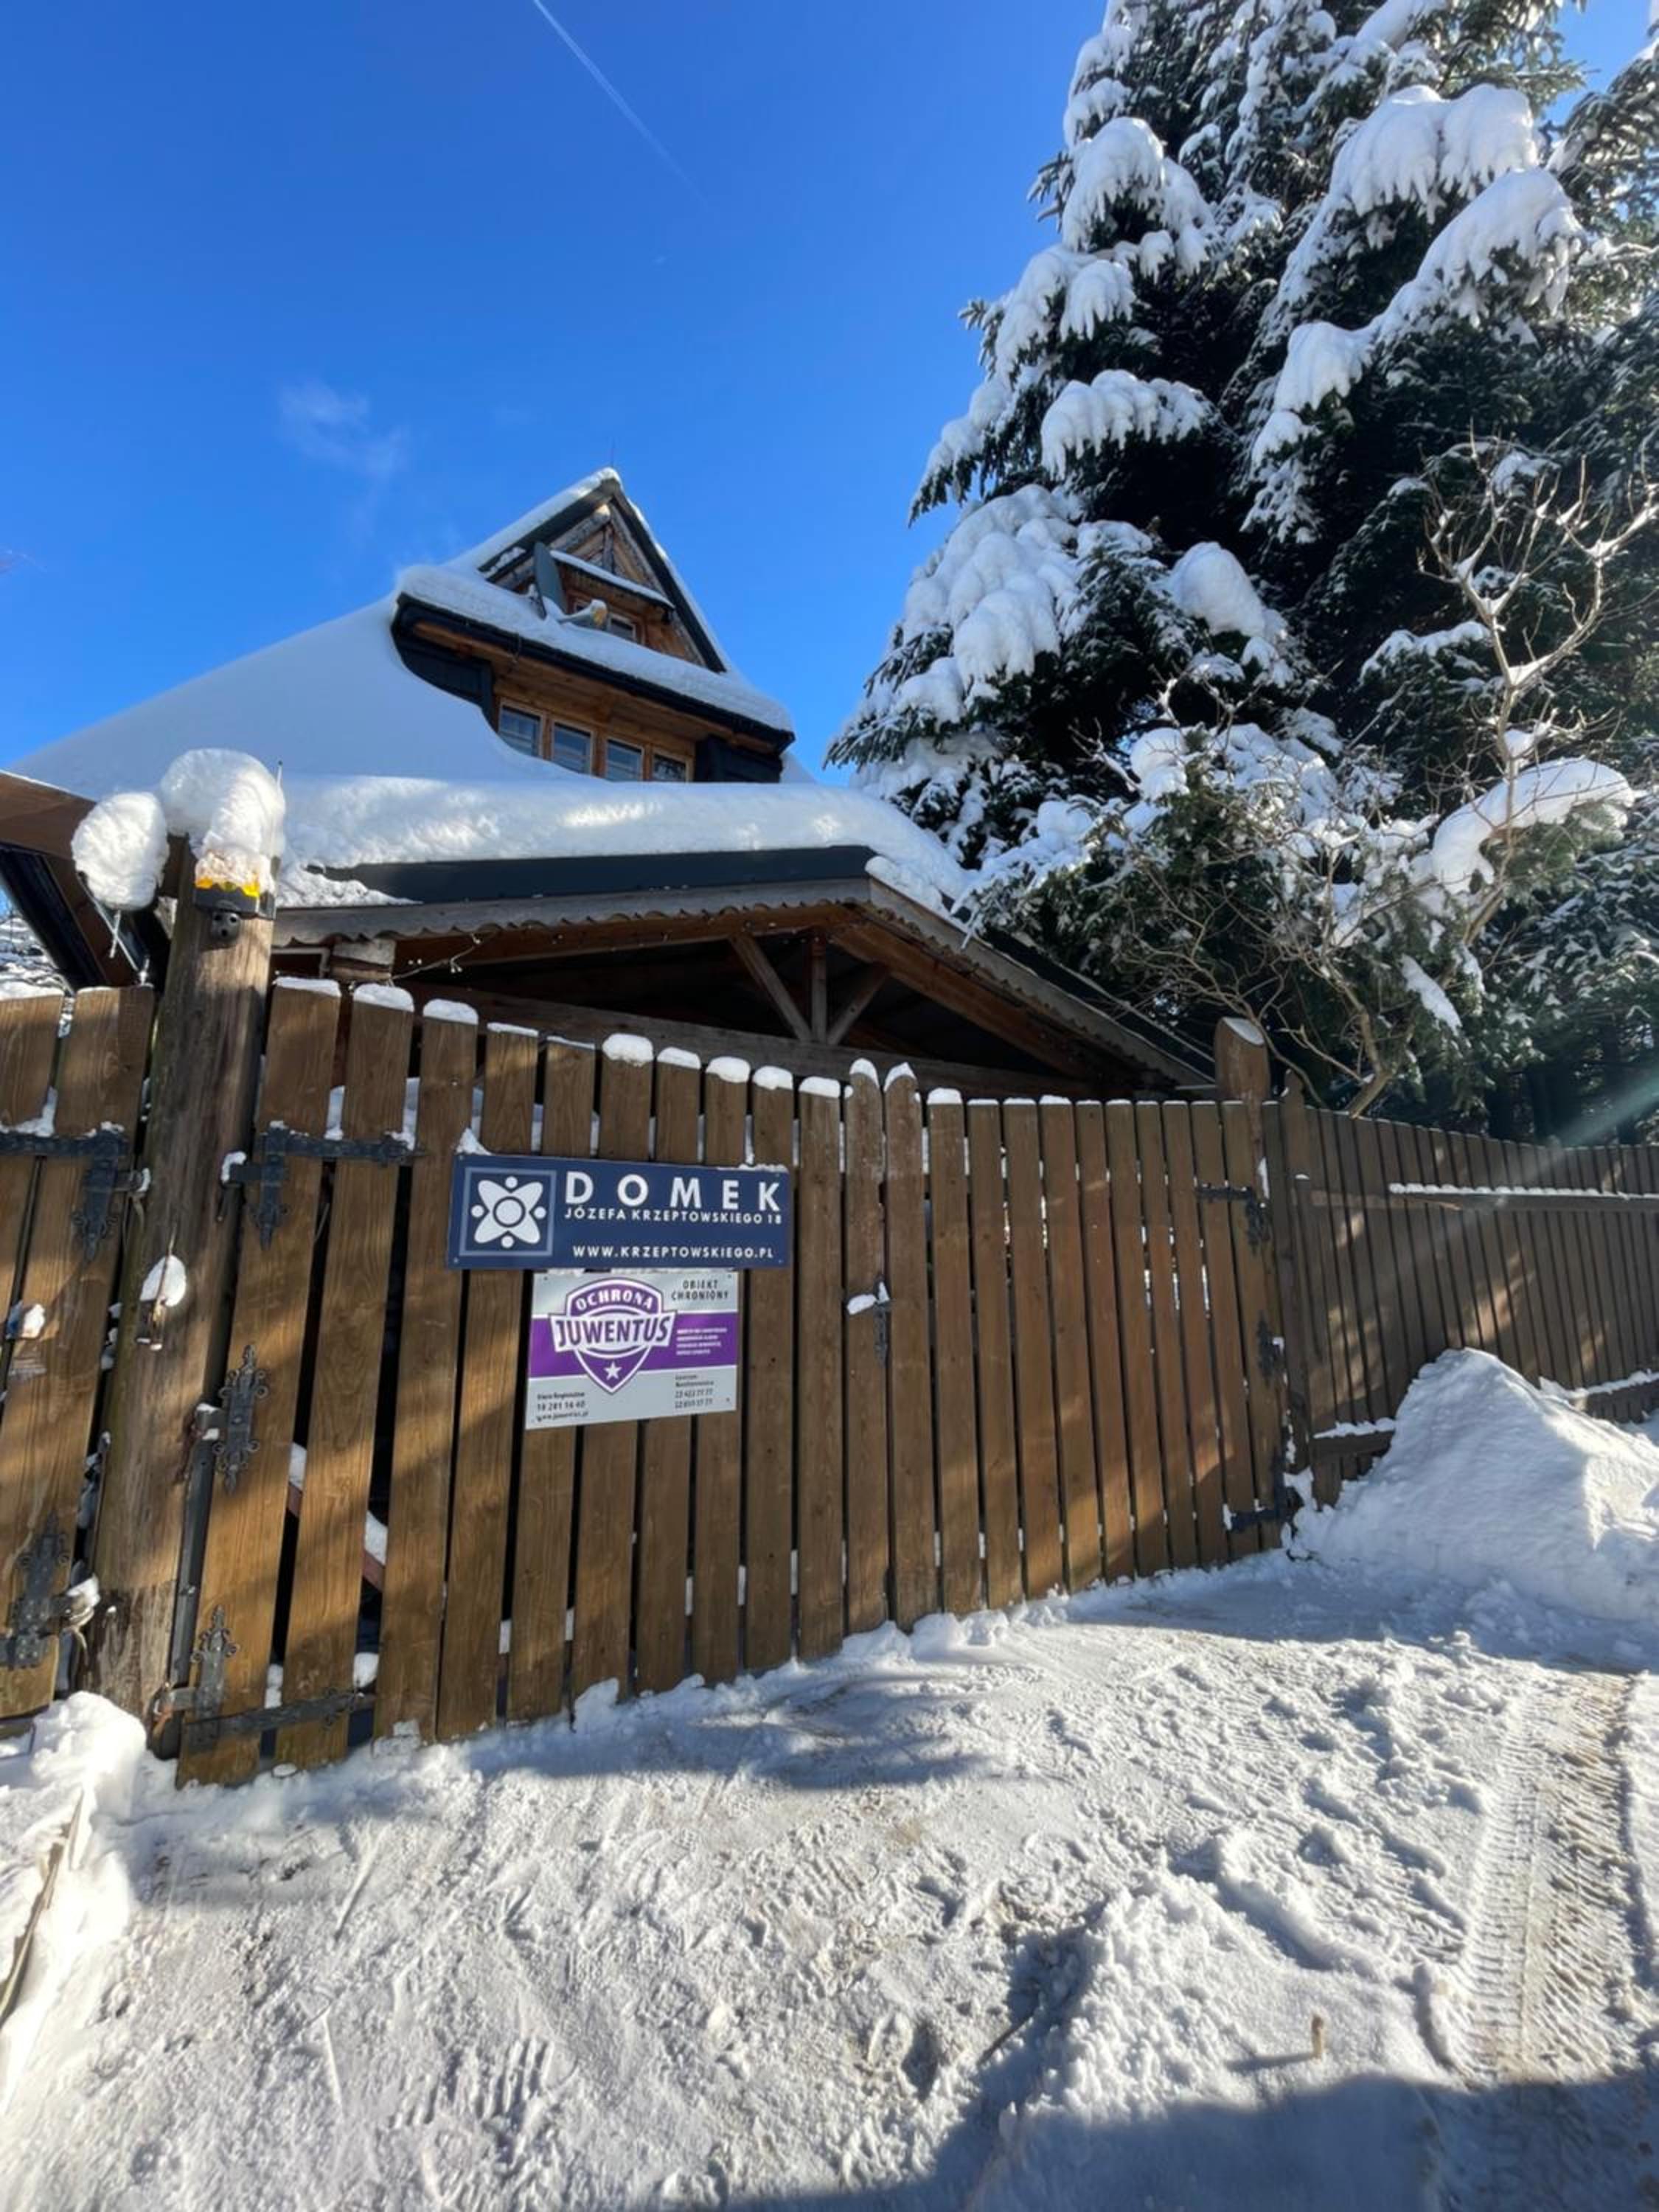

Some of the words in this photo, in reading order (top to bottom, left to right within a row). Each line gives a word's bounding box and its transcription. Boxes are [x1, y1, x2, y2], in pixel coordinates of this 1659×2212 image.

[565, 1171, 780, 1211] DOMEK
[565, 1206, 627, 1220] JÓZEFA
[632, 1209, 763, 1224] KRZEPTOWSKIEGO
[768, 1214, 782, 1225] 18
[572, 1245, 773, 1259] WWW.KRZEPTOWSKIEGO.PL
[683, 1279, 718, 1290] OBIEKT
[576, 1289, 653, 1311] OCHRONA
[671, 1290, 728, 1301] CHRONIONY
[555, 1316, 671, 1348] JUWENTUS
